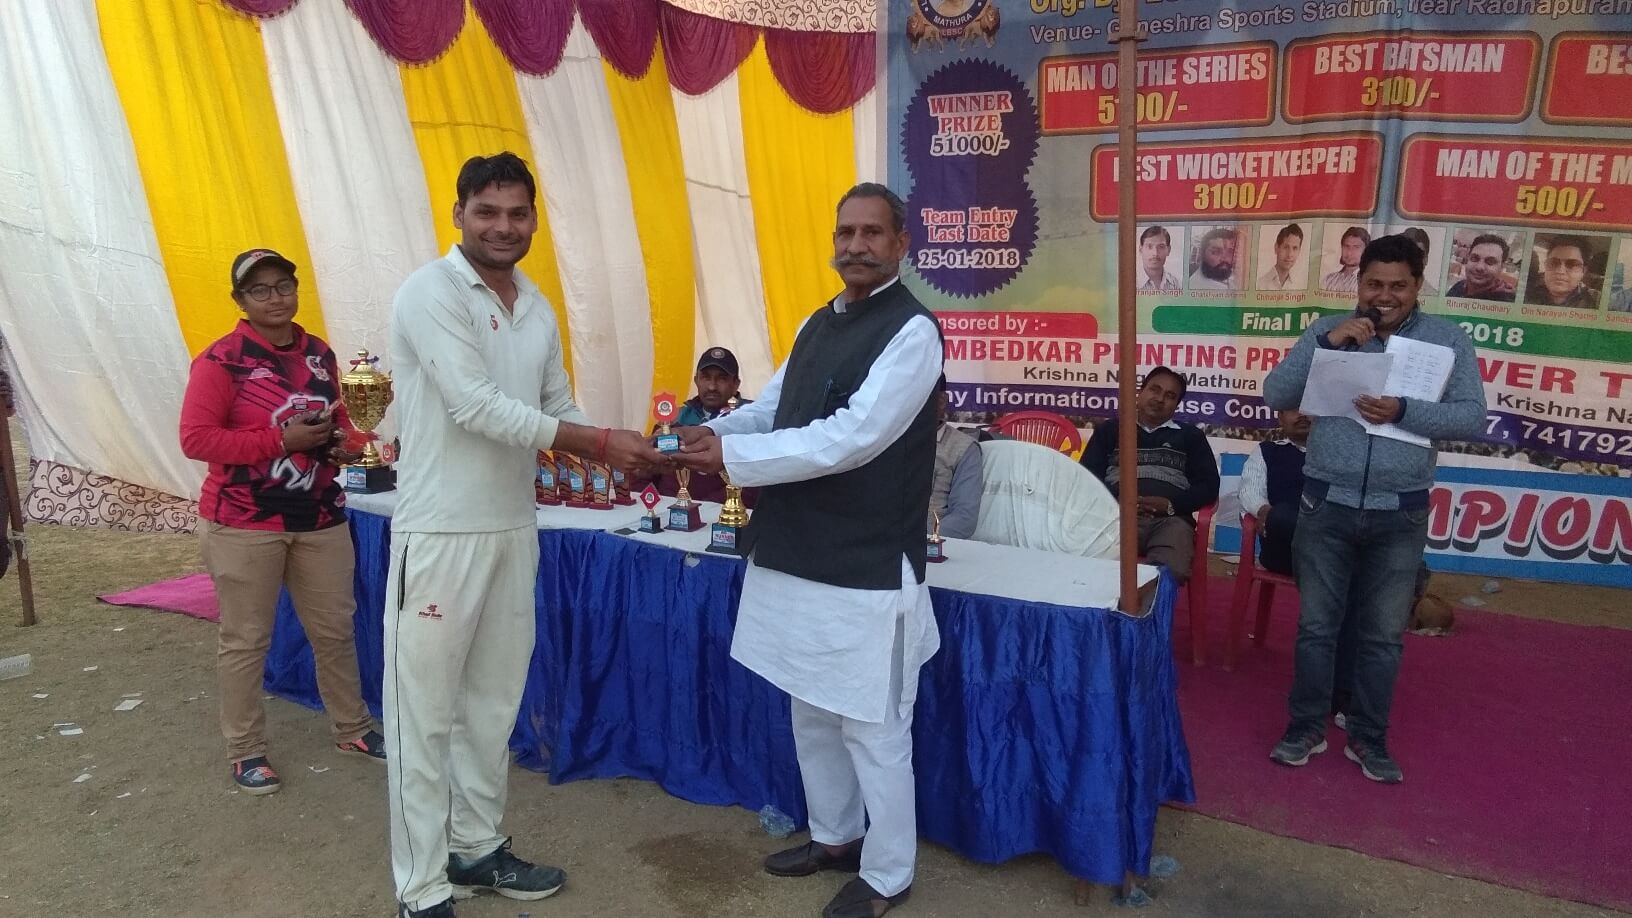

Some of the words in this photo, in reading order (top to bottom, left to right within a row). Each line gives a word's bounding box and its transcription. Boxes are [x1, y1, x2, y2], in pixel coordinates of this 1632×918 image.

[933, 13, 973, 27] MATHURA
[1031, 24, 1102, 44] Venue-
[1107, 13, 1212, 35] Gneshra
[1218, 5, 1295, 32] Sports
[1302, 0, 1403, 22] Stadium,
[1314, 43, 1379, 75] BEST
[1383, 41, 1505, 74] BATSMAN
[1047, 64, 1096, 93] MAN
[1101, 64, 1120, 90] O
[1182, 51, 1268, 85] SERIES
[1360, 76, 1440, 107] 3100/-
[929, 93, 1012, 115] WINNER
[940, 114, 1000, 134] PRIZE
[931, 134, 1009, 156] 51000/-
[1176, 146, 1357, 181] WICKETKEEPER
[1435, 149, 1500, 179] MAN
[1505, 151, 1541, 181] OF
[1549, 153, 1606, 183] THE
[1193, 182, 1278, 210] 3100/-
[1514, 185, 1604, 217] 500/-
[923, 209, 964, 225] Team
[969, 207, 1017, 228] Entry
[928, 226, 964, 241] Last
[968, 225, 1009, 242] Date
[919, 249, 1019, 268] 25-01-2018
[1005, 315, 1028, 334] by
[1242, 313, 1292, 331] Final
[1023, 367, 1099, 383] Krishna
[976, 387, 1119, 410] Information
[1497, 392, 1596, 421] Krishna
[1521, 420, 1632, 457] 741792
